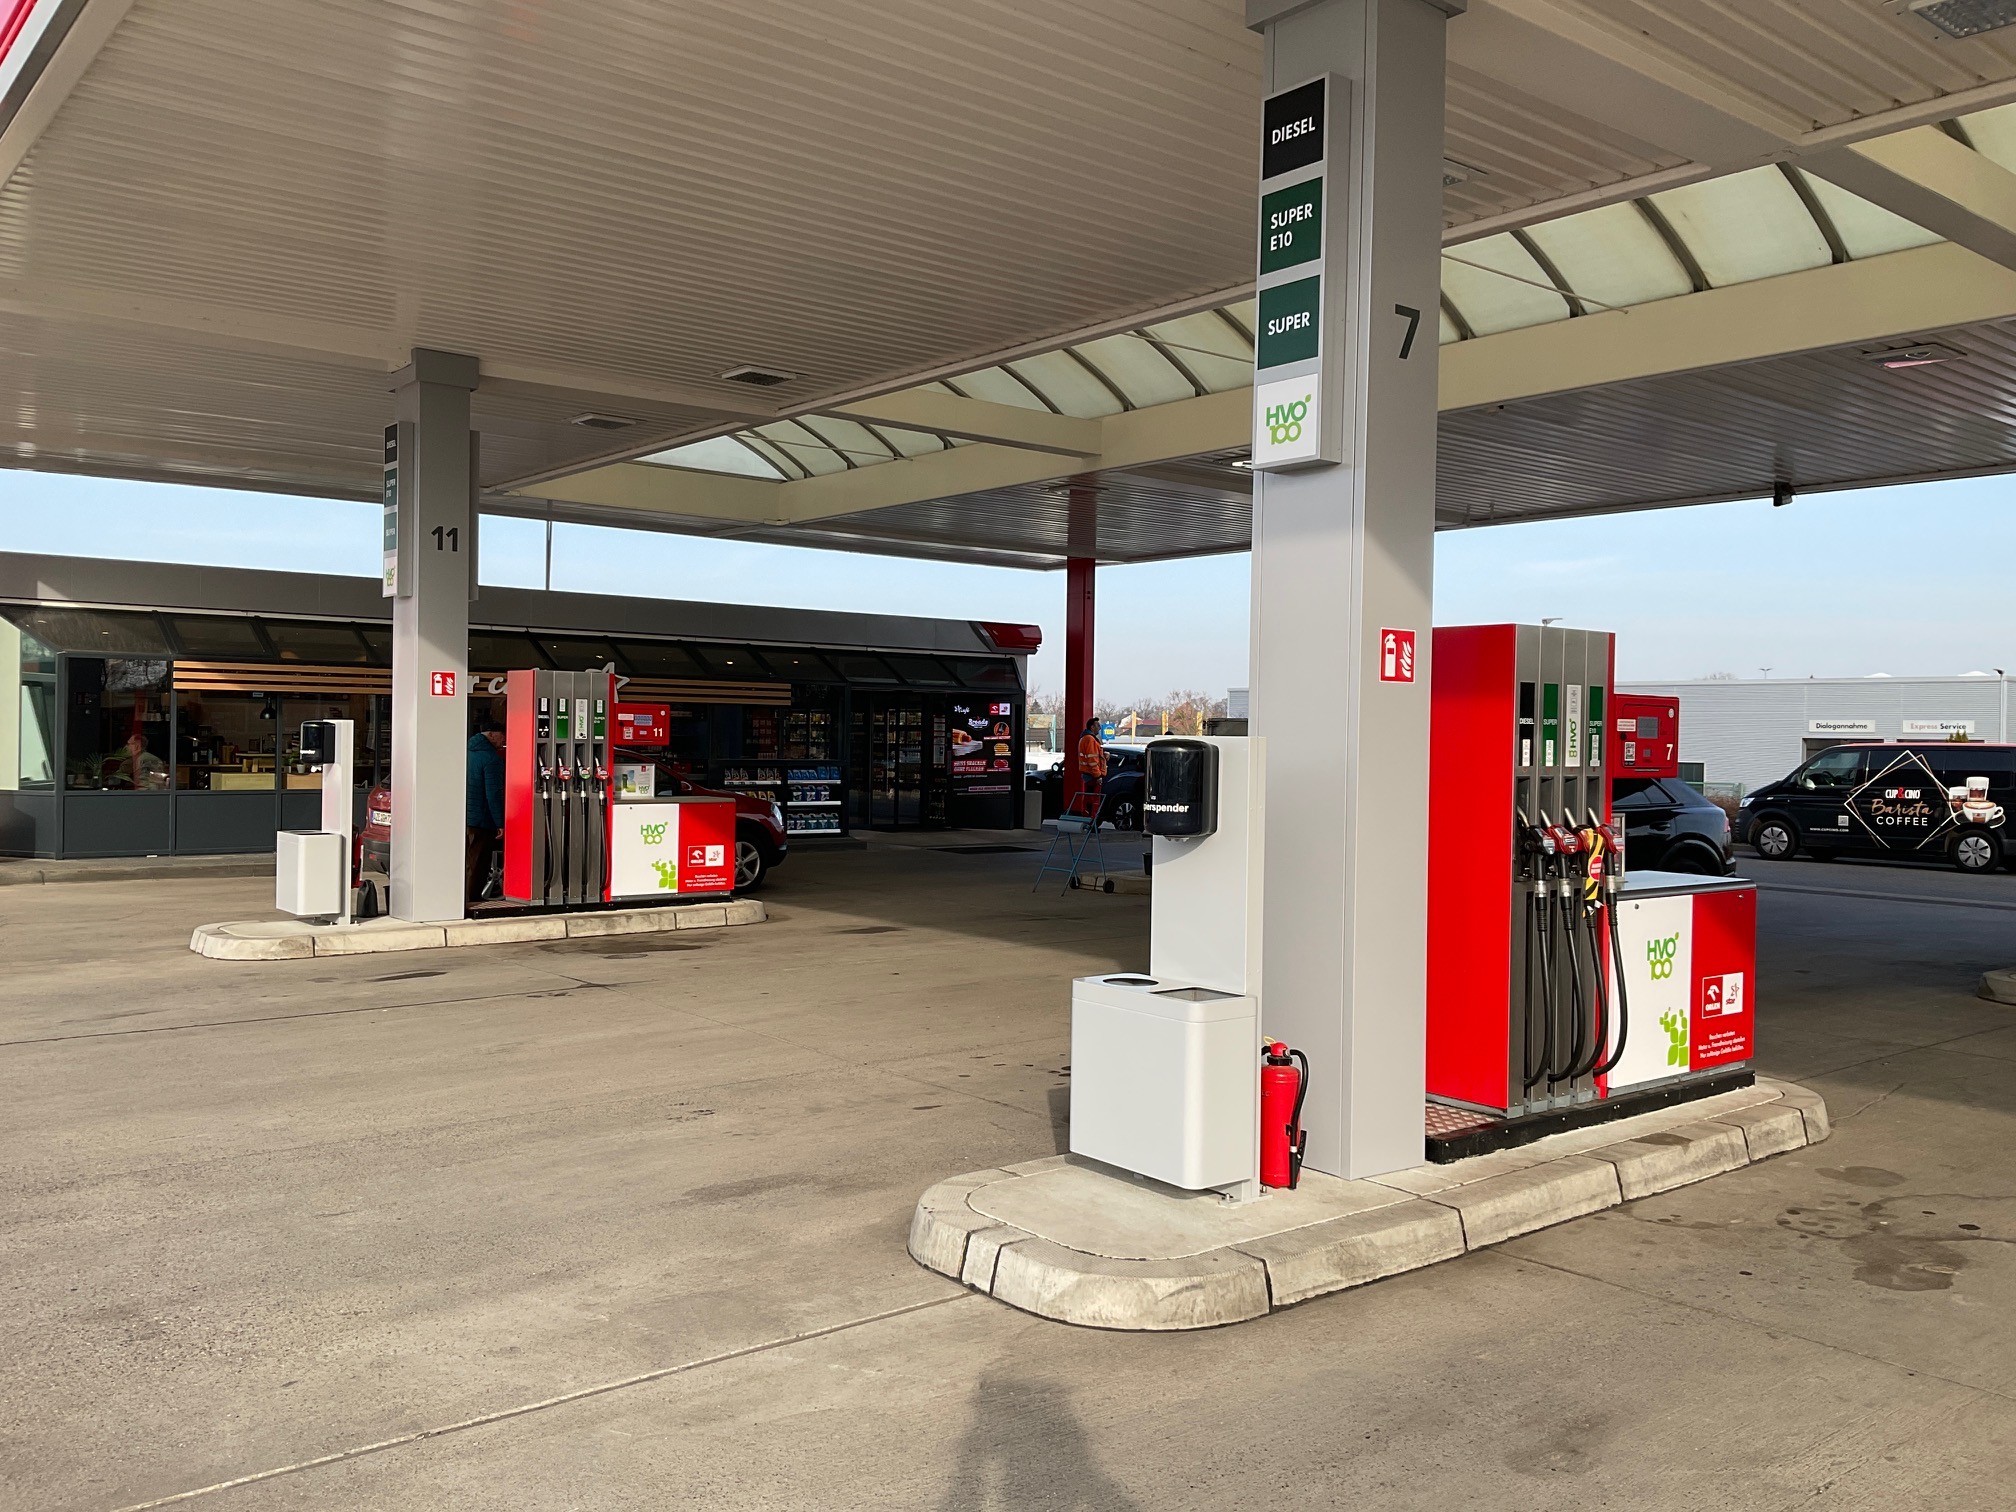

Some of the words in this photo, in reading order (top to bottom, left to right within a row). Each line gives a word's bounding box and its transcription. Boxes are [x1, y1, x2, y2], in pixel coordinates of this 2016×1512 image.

[1271, 116, 1316, 146] DIESEL
[1270, 203, 1313, 230] SUPER
[1270, 231, 1293, 252] E10
[1267, 311, 1311, 336] SUPER
[1394, 303, 1420, 360] 7
[1266, 398, 1307, 427] HVO
[1269, 422, 1302, 445] 100
[431, 526, 458, 552] 11
[1519, 717, 1534, 725] DIESEL
[1815, 722, 1868, 730] Dialogannahme
[1910, 723, 1938, 731] Express
[653, 727, 663, 737] 11
[1666, 743, 1674, 761] 7
[1871, 798, 1933, 817] Barista
[640, 823, 666, 835] HVO
[1876, 816, 1928, 826] COFFEE
[643, 834, 662, 845] 100
[1647, 937, 1676, 961] HVO
[1649, 958, 1673, 980] 100
[1705, 1002, 1721, 1012] ORLEN
